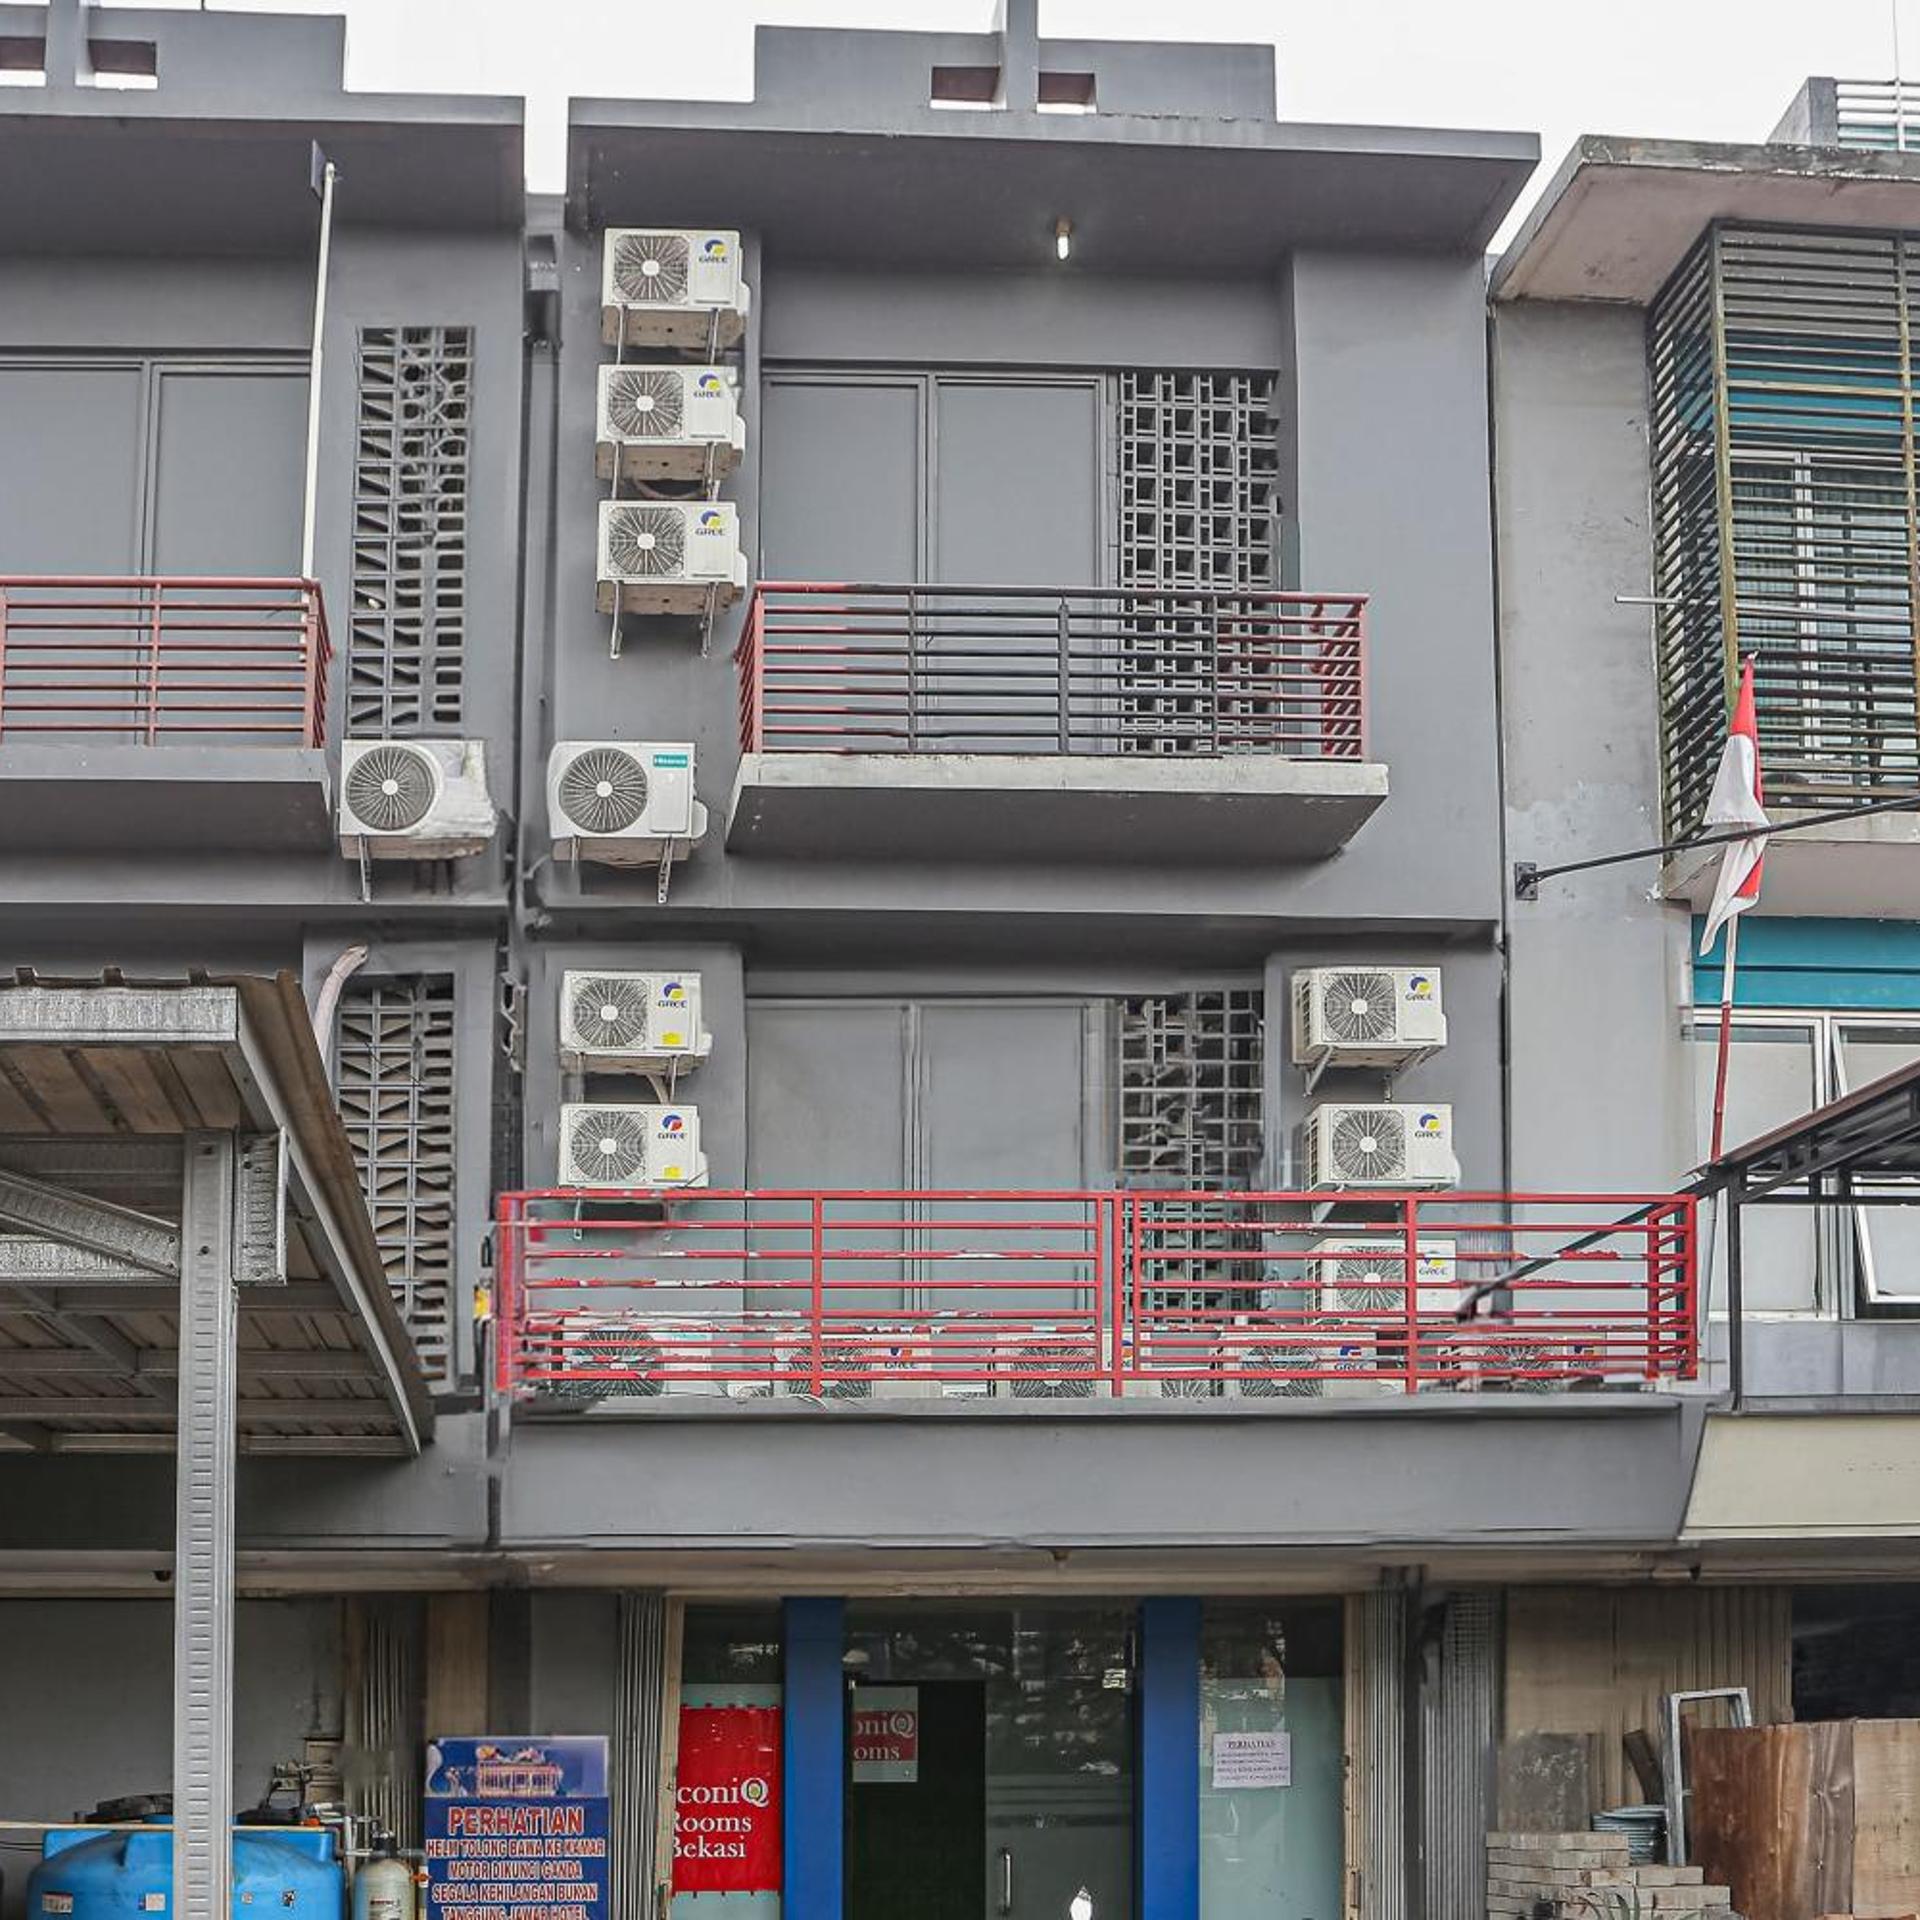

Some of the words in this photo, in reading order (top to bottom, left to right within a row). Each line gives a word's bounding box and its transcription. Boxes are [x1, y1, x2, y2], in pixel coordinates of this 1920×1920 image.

[448, 1806, 584, 1836] PERHATIAN
[426, 1839, 459, 1857] HELM
[460, 1839, 507, 1857] TOLONG
[509, 1839, 543, 1857] BAWA
[545, 1839, 560, 1857] KE
[448, 1861, 490, 1880] MOTOR
[491, 1861, 540, 1880] DIKUNCI
[541, 1861, 583, 1880] GANDA
[432, 1883, 481, 1903] SEGALA
[482, 1883, 555, 1903] KEHILANGAN
[556, 1883, 597, 1903] BUKAN
